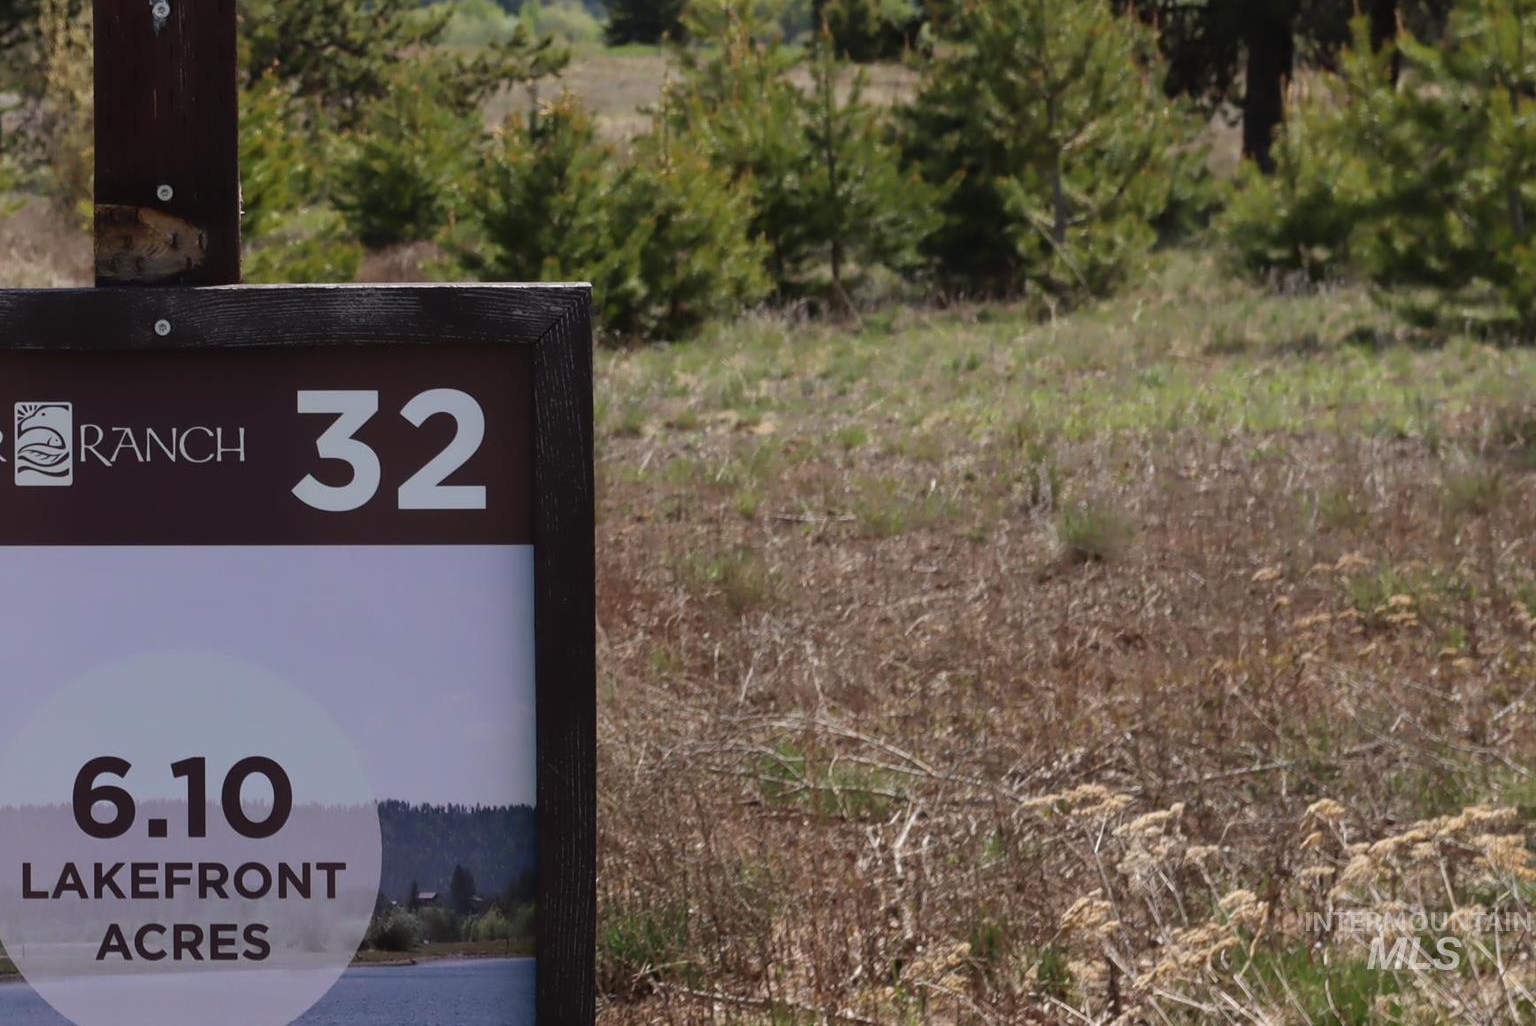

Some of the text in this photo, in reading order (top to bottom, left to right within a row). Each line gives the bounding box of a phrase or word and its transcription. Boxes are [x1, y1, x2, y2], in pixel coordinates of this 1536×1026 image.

[79, 423, 246, 468] RANCH
[291, 387, 487, 512] 32
[71, 755, 293, 840] 6.10
[21, 861, 347, 901] LAKEFRONT
[96, 922, 271, 962] ACRES
